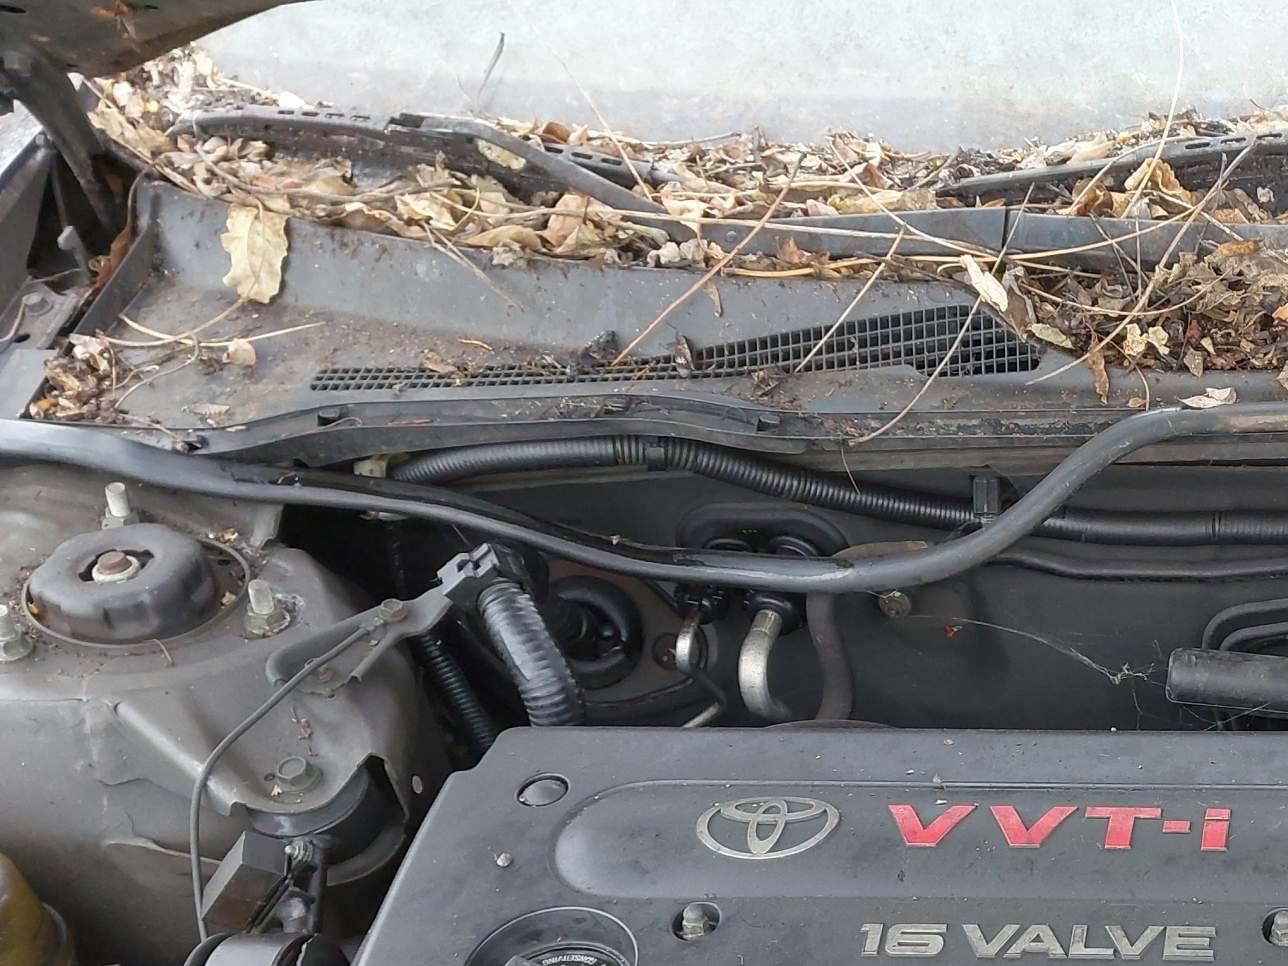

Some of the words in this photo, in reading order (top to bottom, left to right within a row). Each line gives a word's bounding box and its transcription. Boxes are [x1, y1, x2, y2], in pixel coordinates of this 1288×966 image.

[888, 804, 1231, 852] VVT-i
[860, 923, 948, 957] 16
[962, 924, 1216, 961] VALVE
